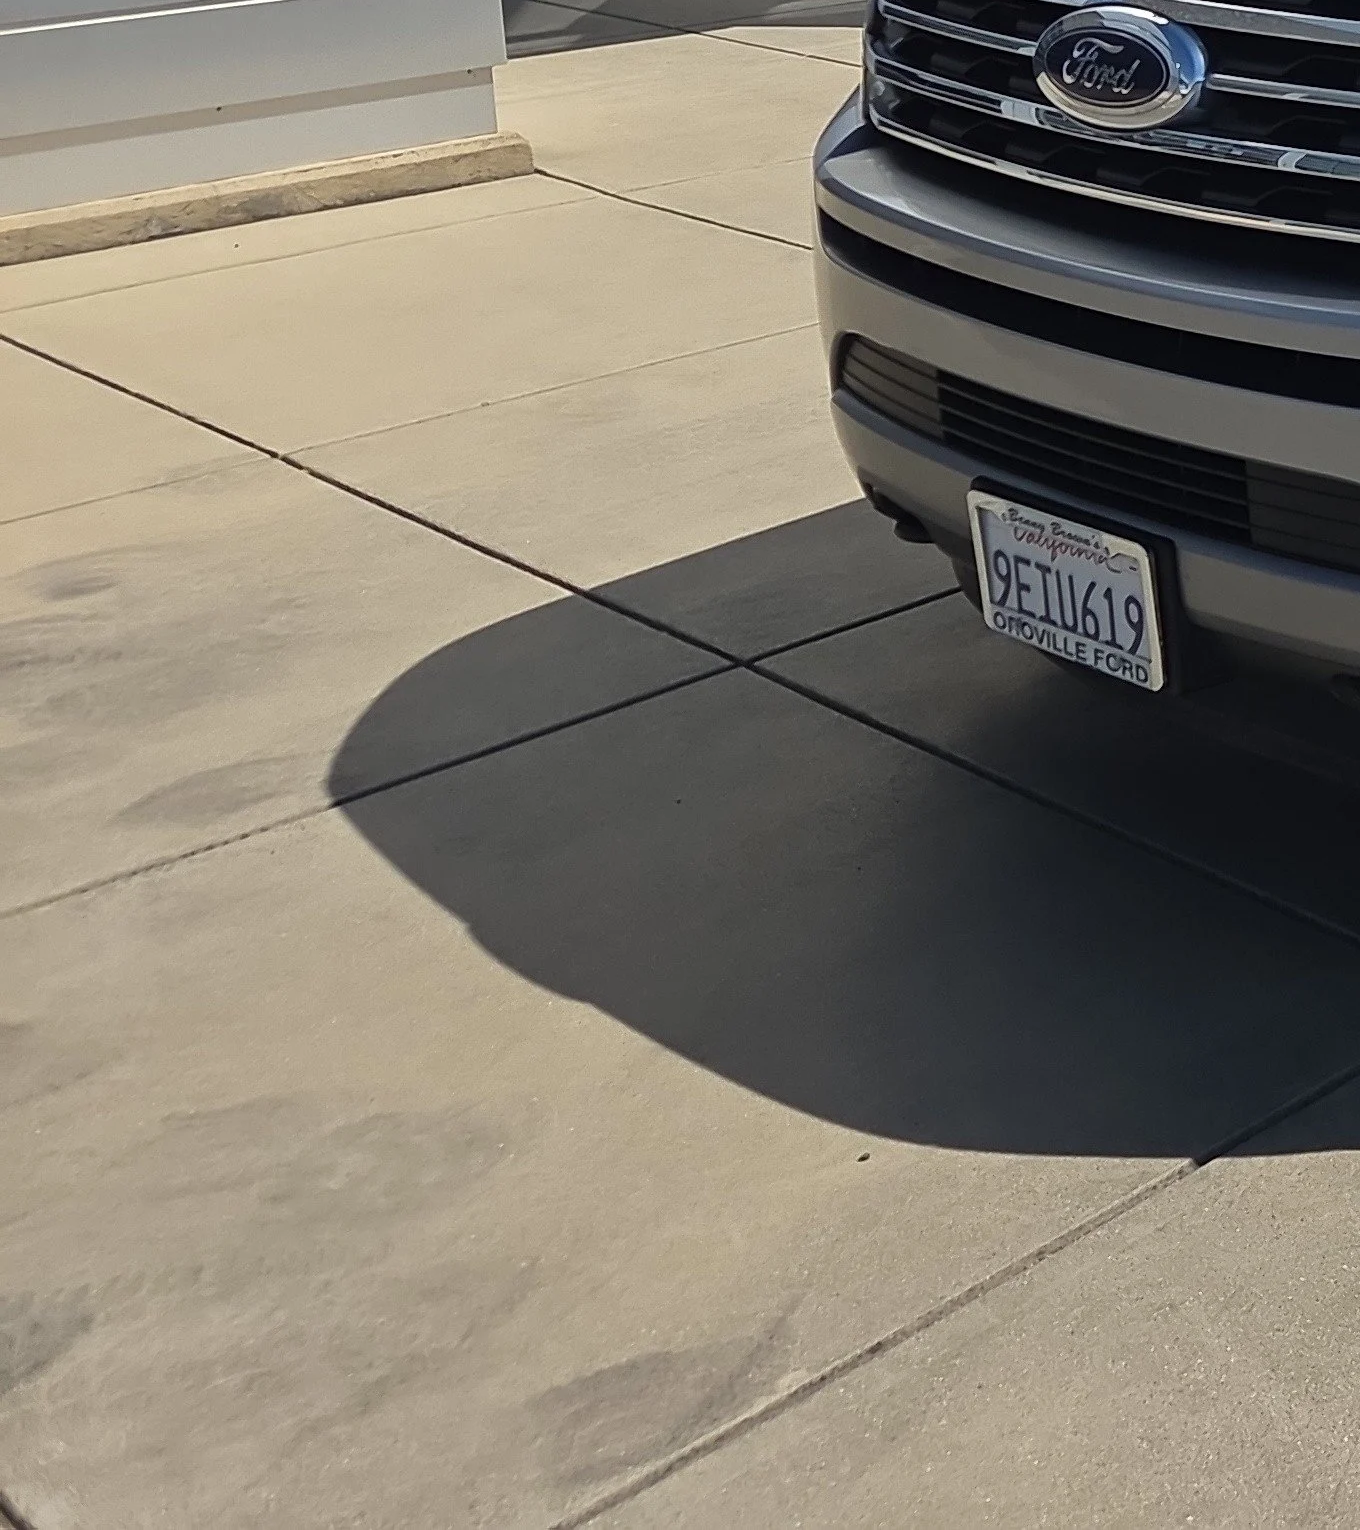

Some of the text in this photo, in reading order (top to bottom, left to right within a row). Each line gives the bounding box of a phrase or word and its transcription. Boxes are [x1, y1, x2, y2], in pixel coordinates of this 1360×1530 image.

[1062, 37, 1141, 95] Ford
[993, 549, 1144, 656] 9EIU619
[993, 611, 1149, 683] OROVILLE FORD
